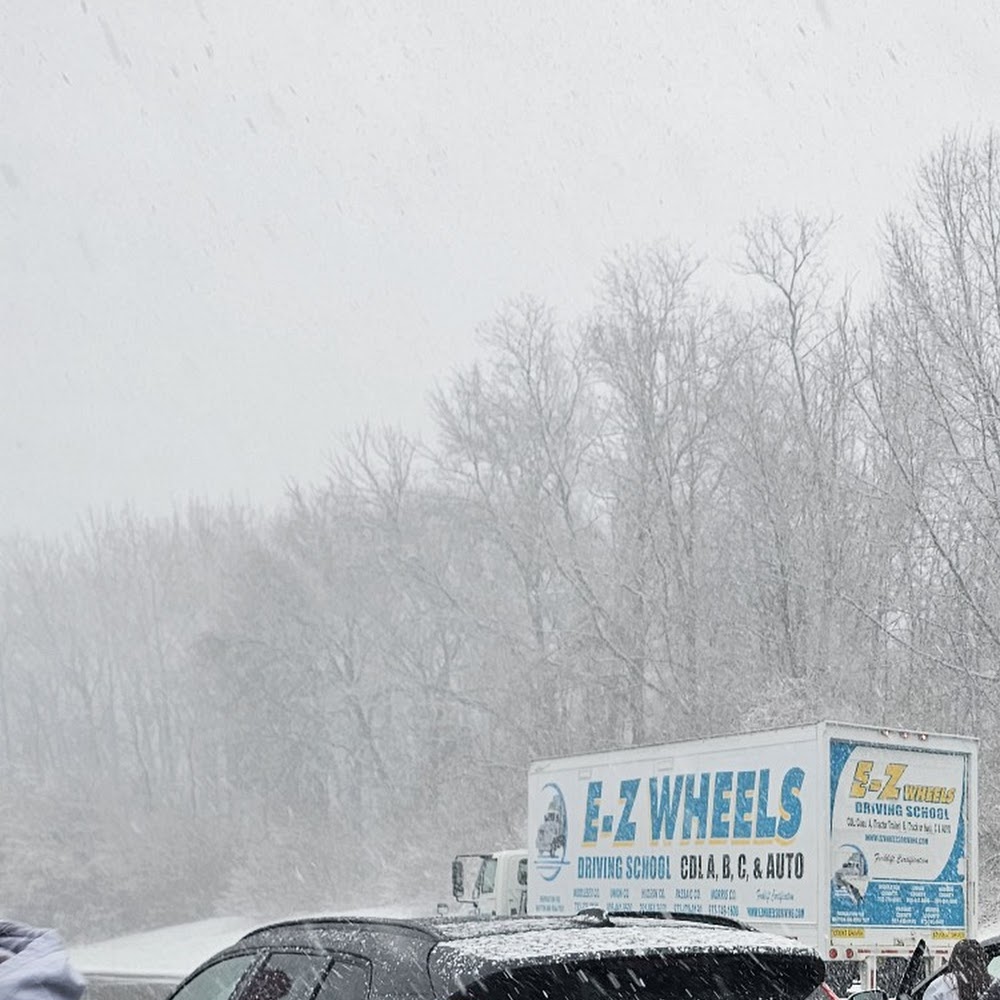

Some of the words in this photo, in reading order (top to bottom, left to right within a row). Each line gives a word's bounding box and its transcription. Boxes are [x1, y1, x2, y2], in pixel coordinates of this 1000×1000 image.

[849, 760, 908, 800] E-Z
[903, 784, 956, 804] WHEELS
[582, 778, 641, 845] E-Z
[649, 767, 805, 846] WHEELS
[855, 802, 903, 817] DRIVING
[906, 805, 950, 820] SCHOOL
[578, 855, 623, 879] DRIVING
[626, 855, 671, 880] SCHOOL
[680, 855, 703, 880] CDL
[706, 854, 718, 881] A,
[723, 854, 734, 881] B,
[738, 853, 749, 881] C,
[753, 857, 763, 880] &
[766, 852, 804, 879] AUTO
